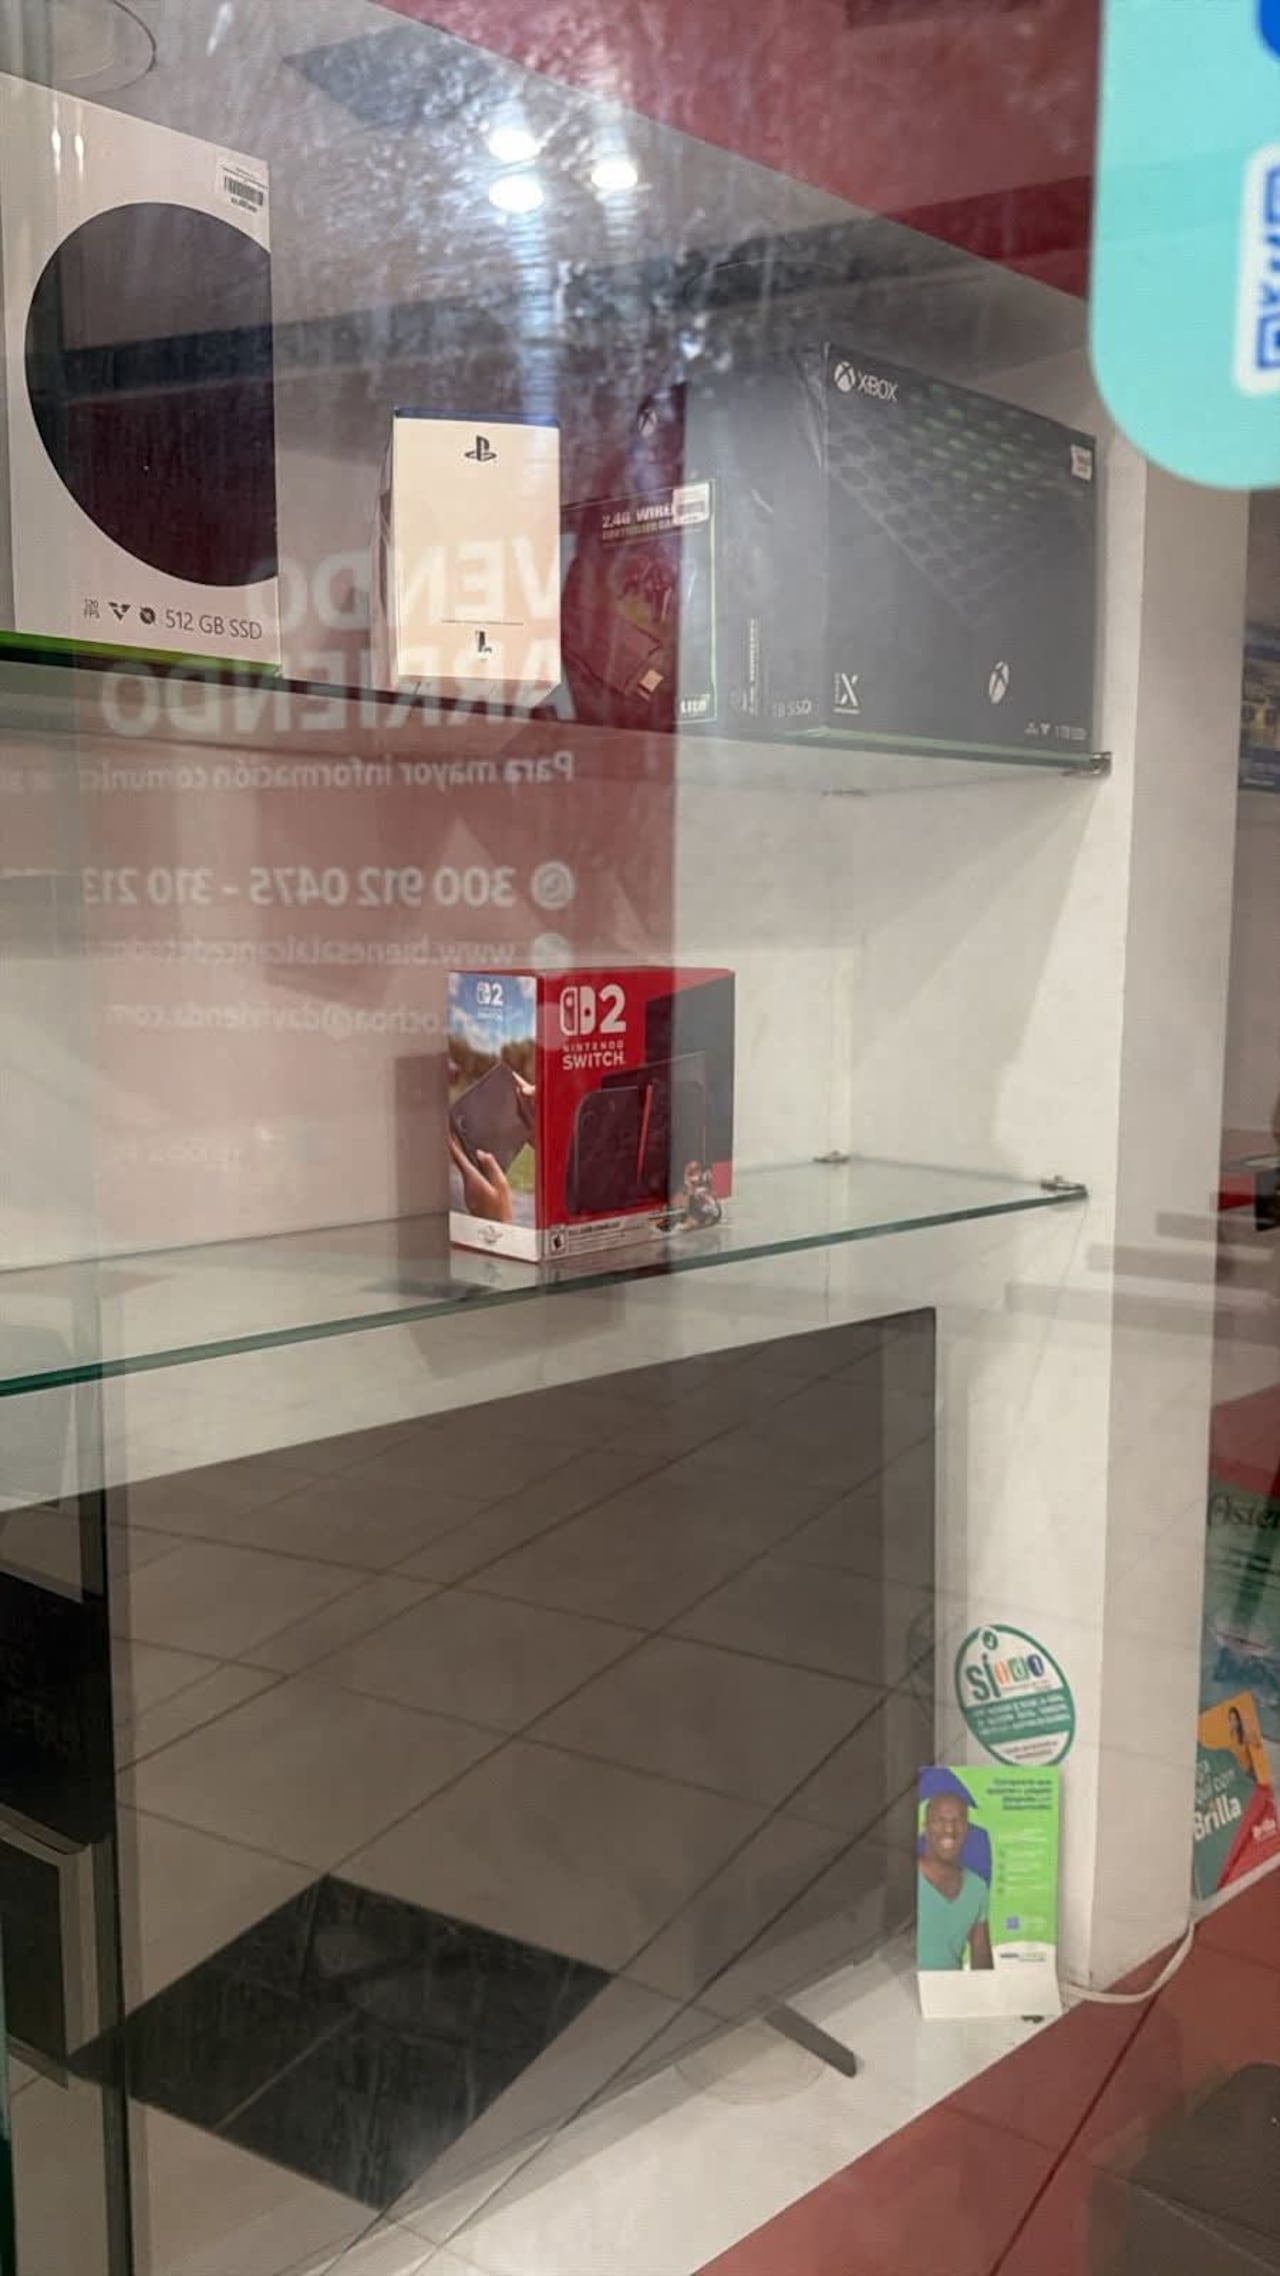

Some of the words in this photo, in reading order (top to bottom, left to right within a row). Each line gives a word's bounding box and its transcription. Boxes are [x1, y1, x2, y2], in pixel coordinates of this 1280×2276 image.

[857, 372, 899, 402] XBOX
[165, 609, 194, 632] 512
[199, 615, 225, 635] GB
[229, 619, 263, 640] SSD
[840, 672, 859, 707] X
[561, 1050, 626, 1071] SWITCH
[562, 1039, 625, 1053] NINTENDO
